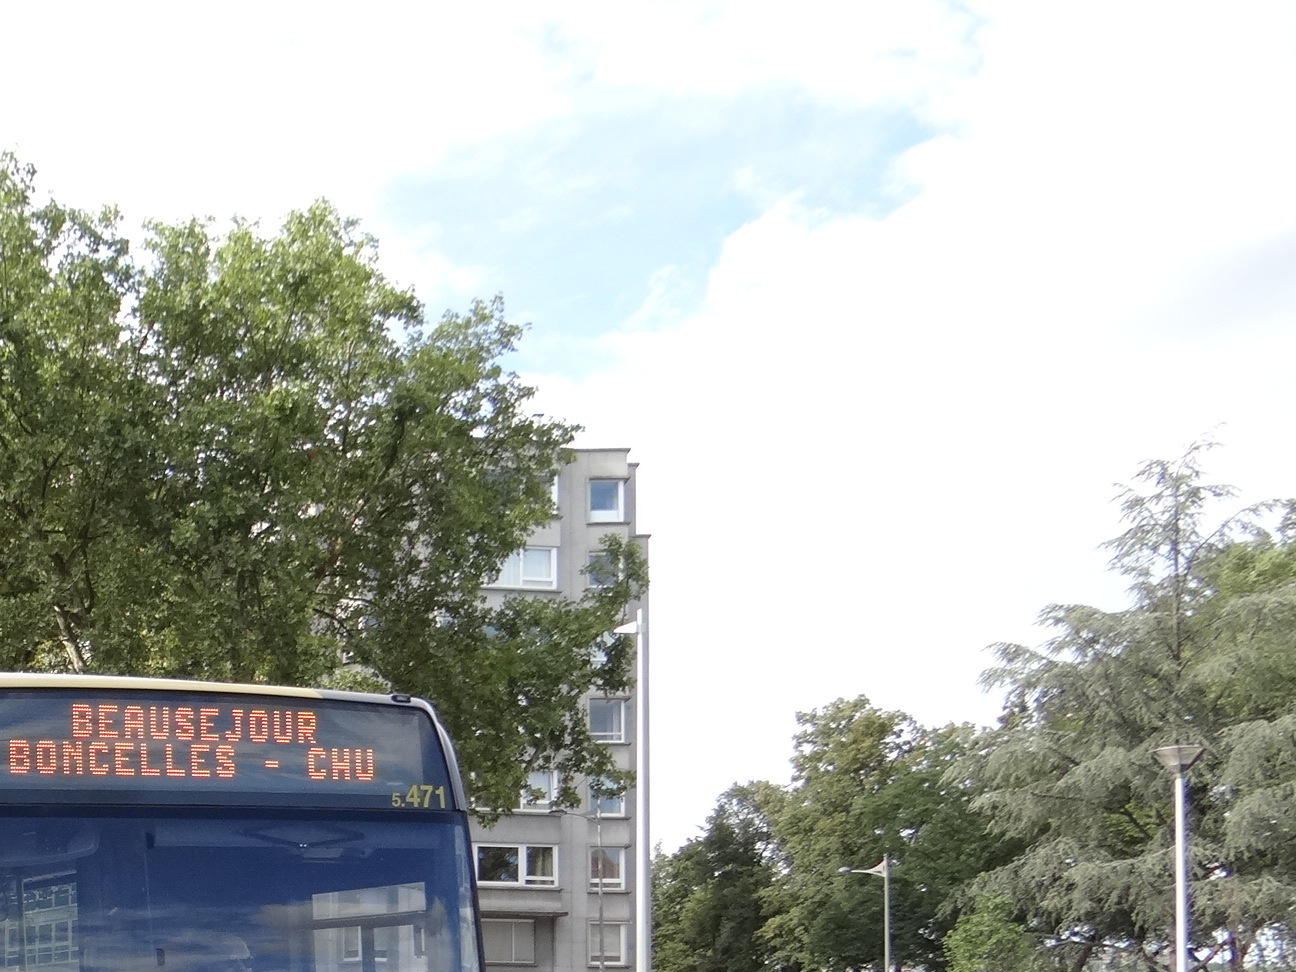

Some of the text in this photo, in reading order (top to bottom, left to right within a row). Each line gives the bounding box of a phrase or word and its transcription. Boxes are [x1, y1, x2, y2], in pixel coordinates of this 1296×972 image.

[72, 702, 317, 744] BEAUSEJOUR
[9, 738, 236, 778] BONCELLES
[307, 747, 374, 781] CHU
[391, 785, 446, 808] 5.471
